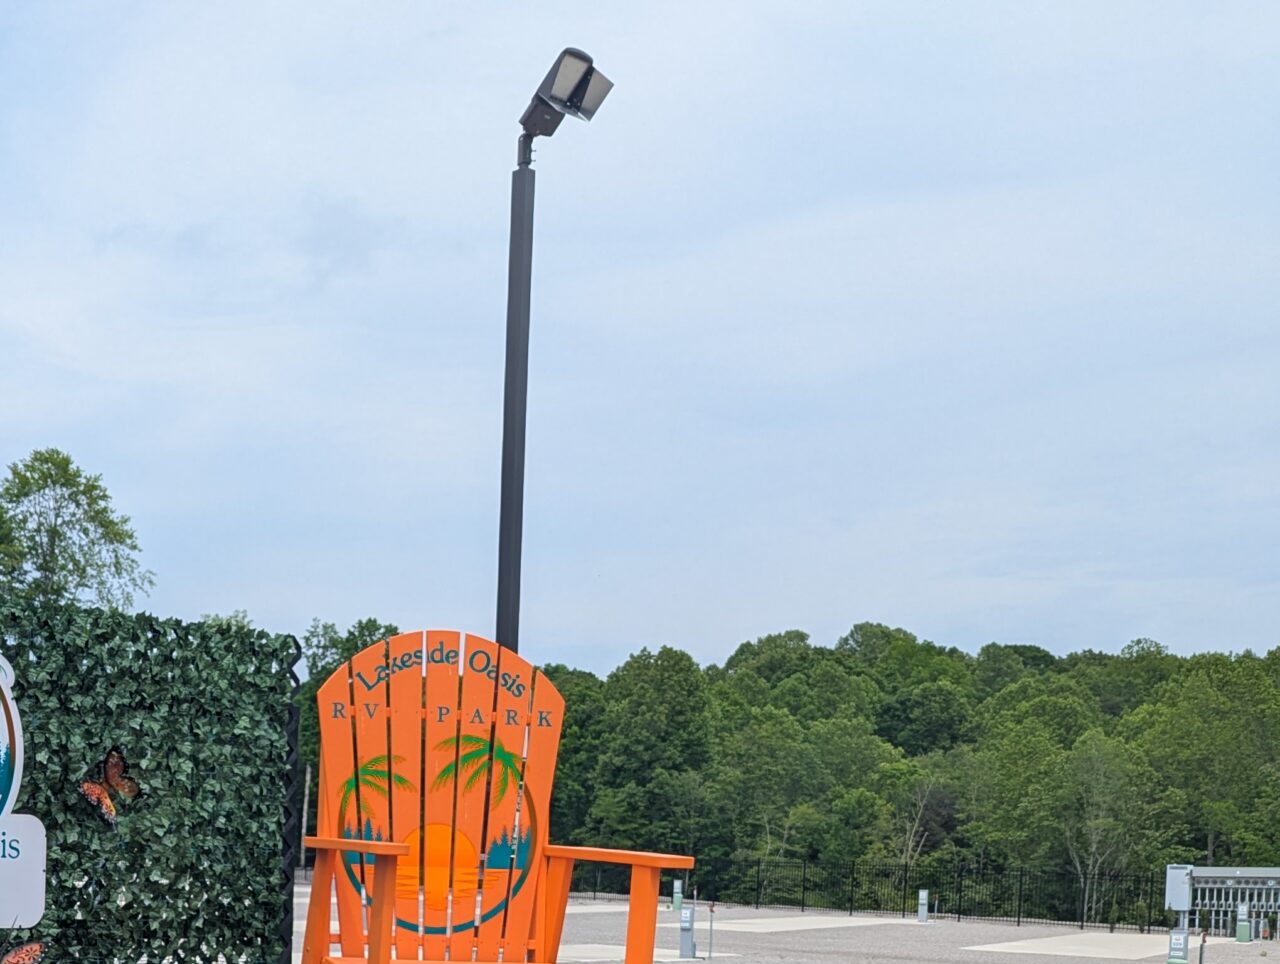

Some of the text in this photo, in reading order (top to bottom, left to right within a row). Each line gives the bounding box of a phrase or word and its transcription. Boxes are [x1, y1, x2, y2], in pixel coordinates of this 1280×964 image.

[355, 640, 526, 698] Lakesde Oasis
[331, 702, 553, 727] RV PARK
